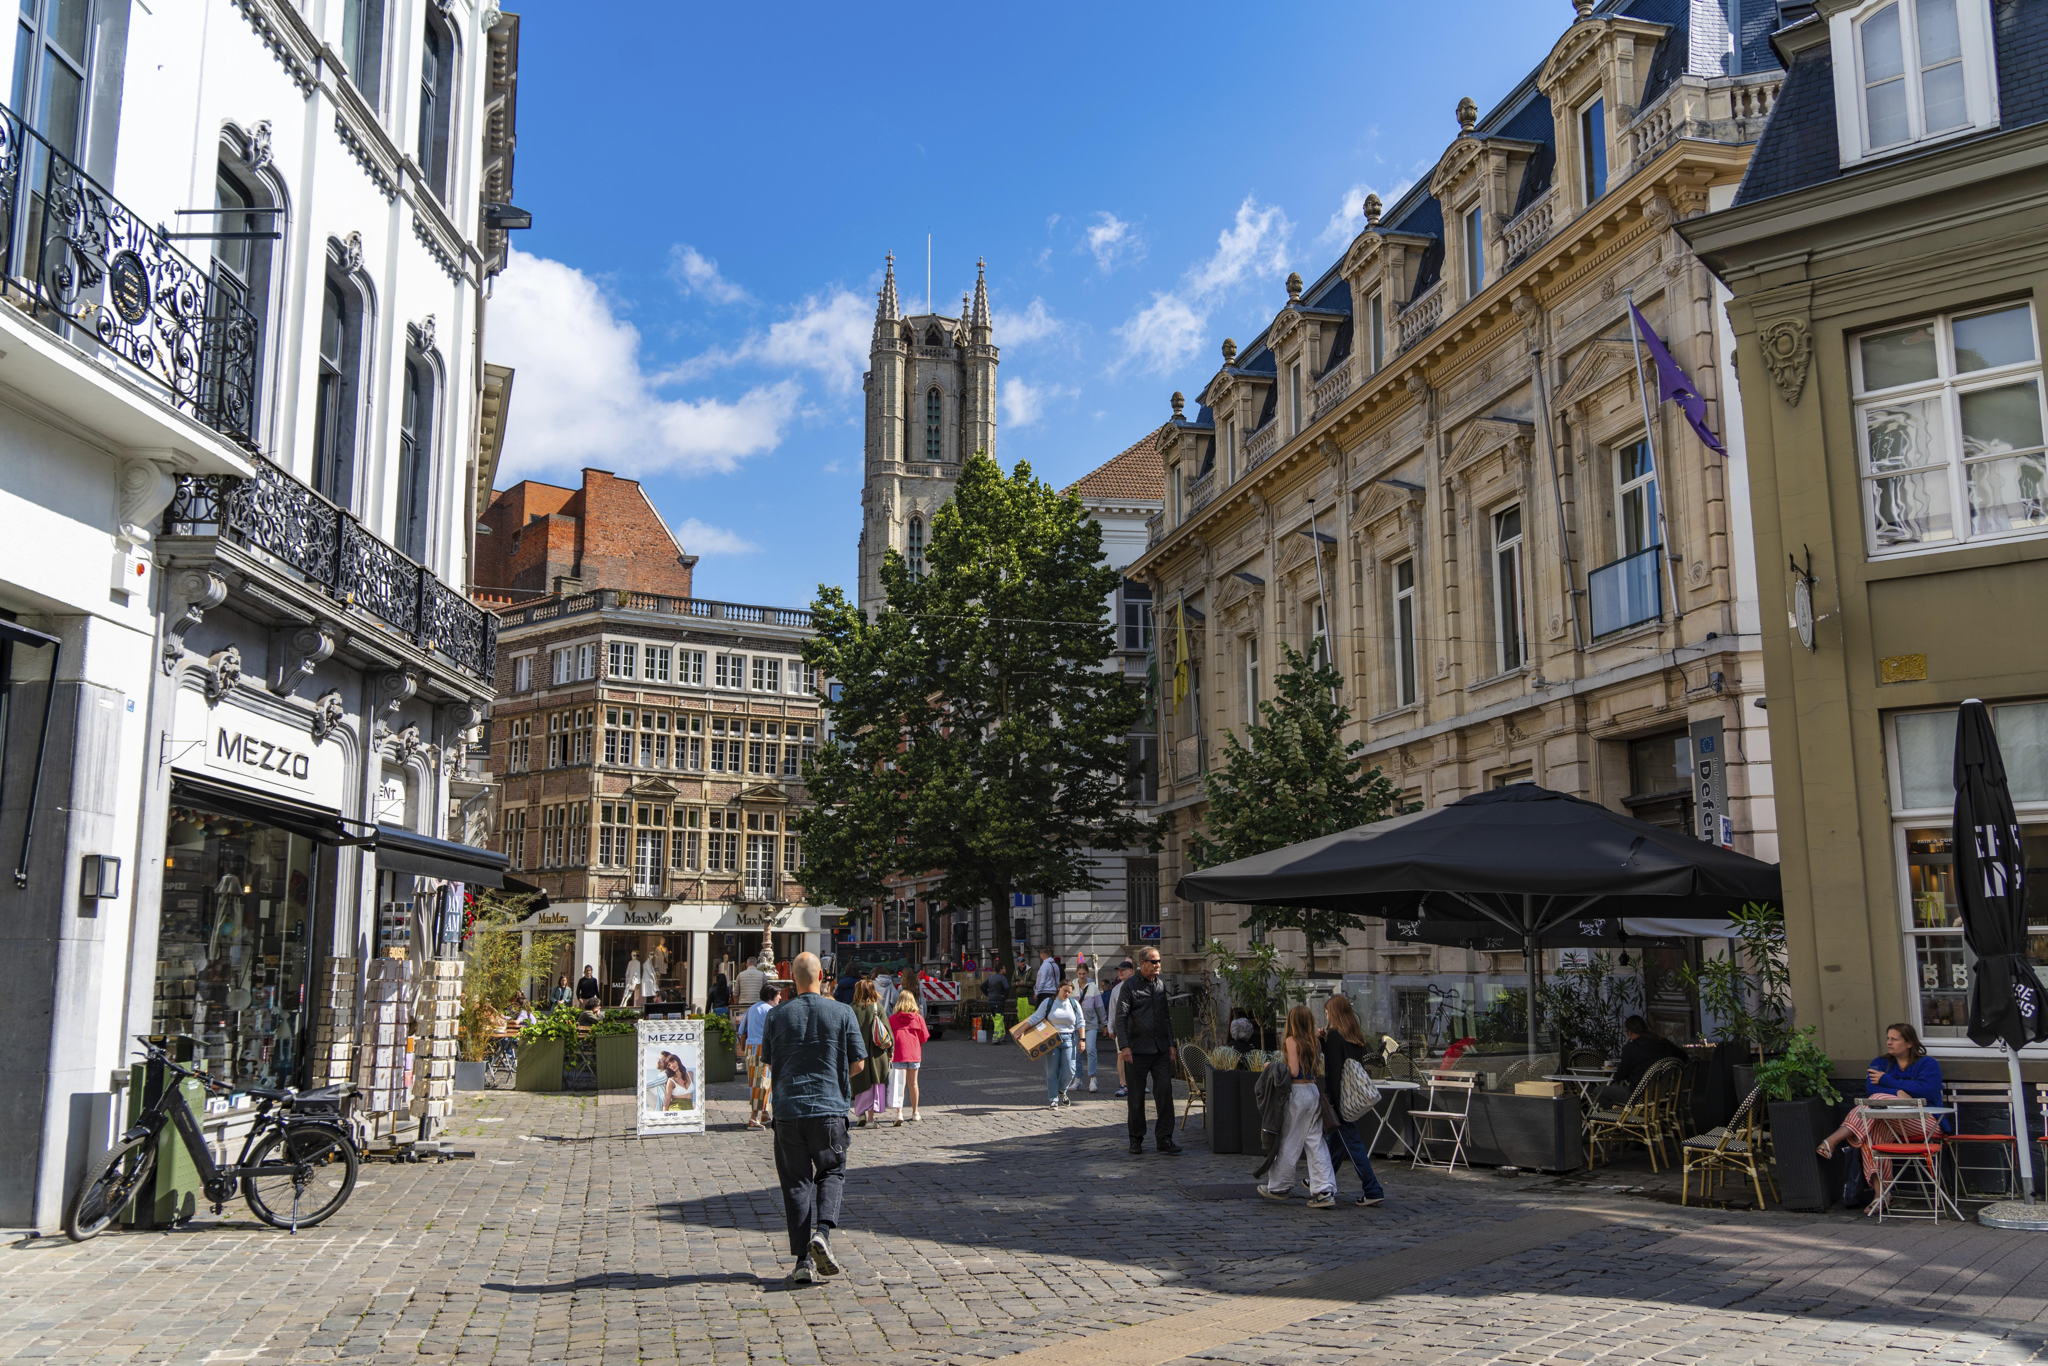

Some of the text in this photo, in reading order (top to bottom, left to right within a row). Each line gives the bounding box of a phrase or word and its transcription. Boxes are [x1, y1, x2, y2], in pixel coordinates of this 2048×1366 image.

[217, 727, 309, 780] MEZZO
[624, 911, 673, 925] MaxMara
[648, 1032, 695, 1042] MEZZO
